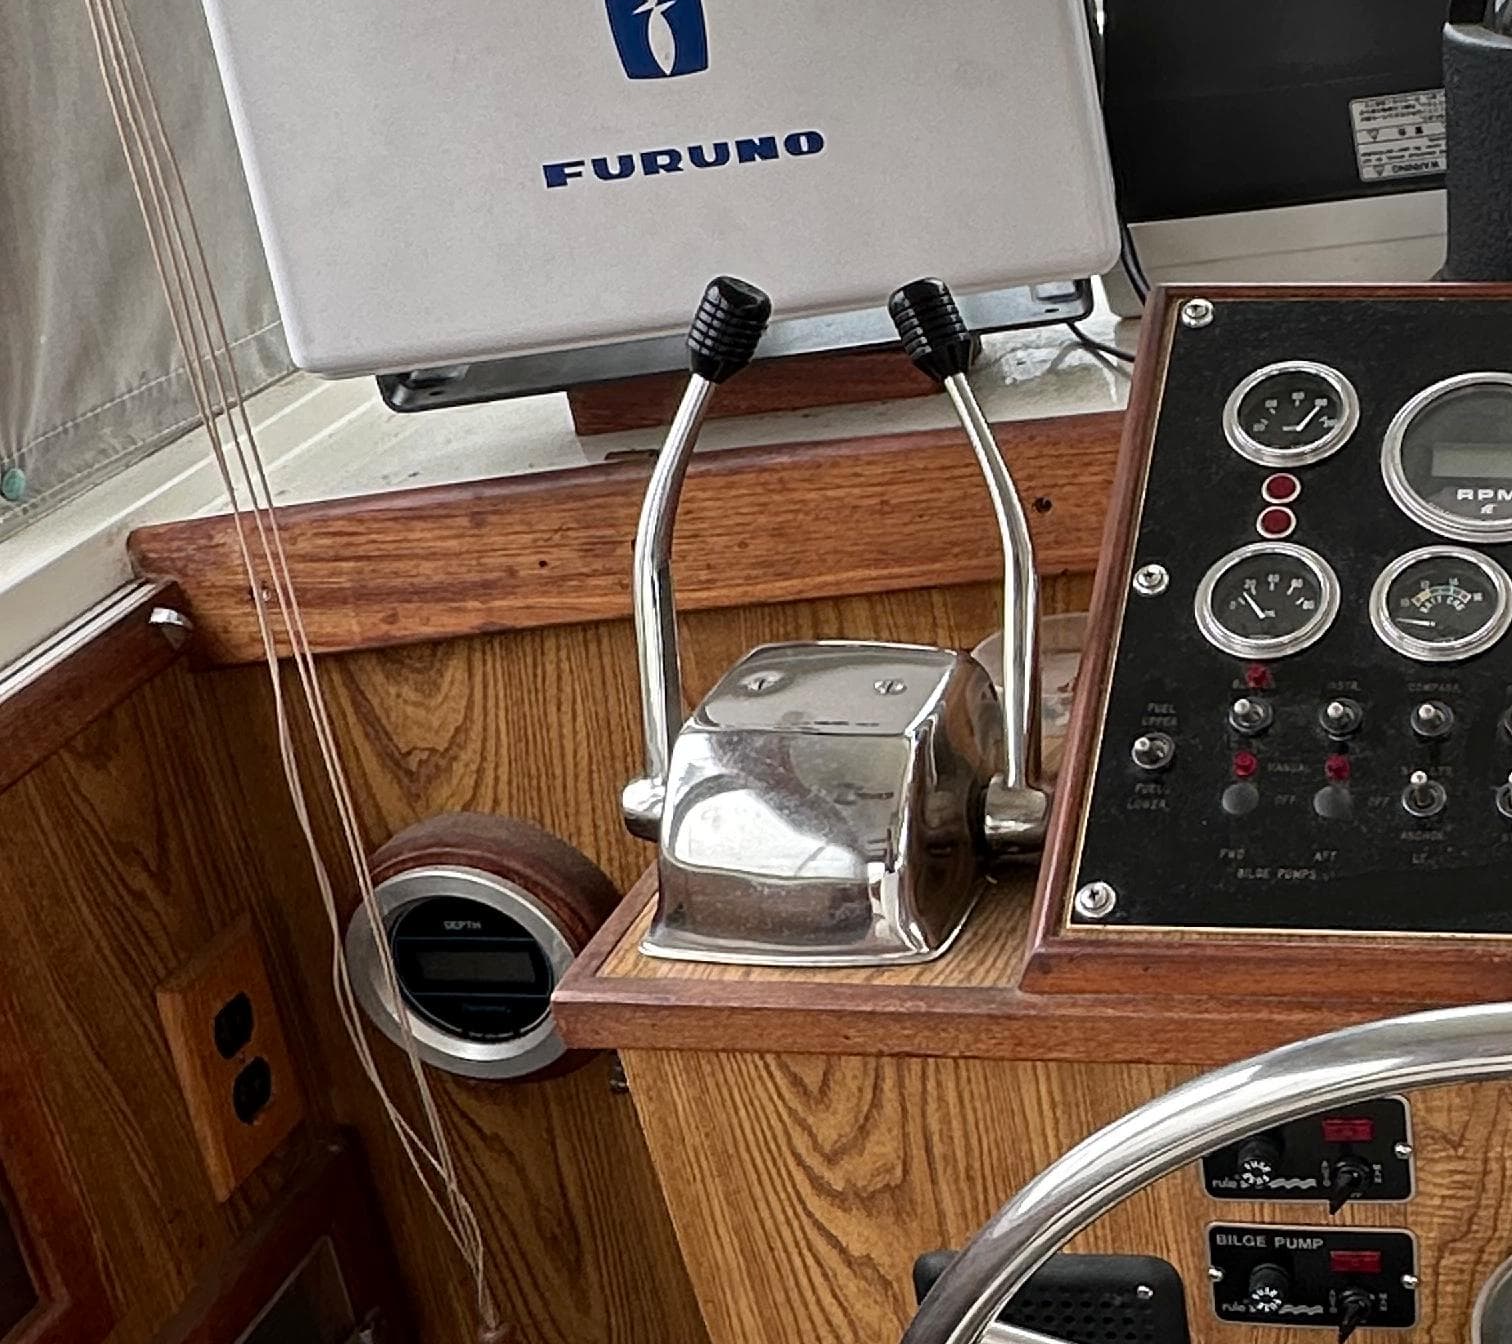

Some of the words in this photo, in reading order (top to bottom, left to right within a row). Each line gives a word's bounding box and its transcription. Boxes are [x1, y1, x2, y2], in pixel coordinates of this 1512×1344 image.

[543, 131, 824, 189] FURUNO
[1391, 161, 1440, 174] WARNING
[1216, 1234, 1267, 1248] BILGE
[1274, 1236, 1324, 1250] PUMP
